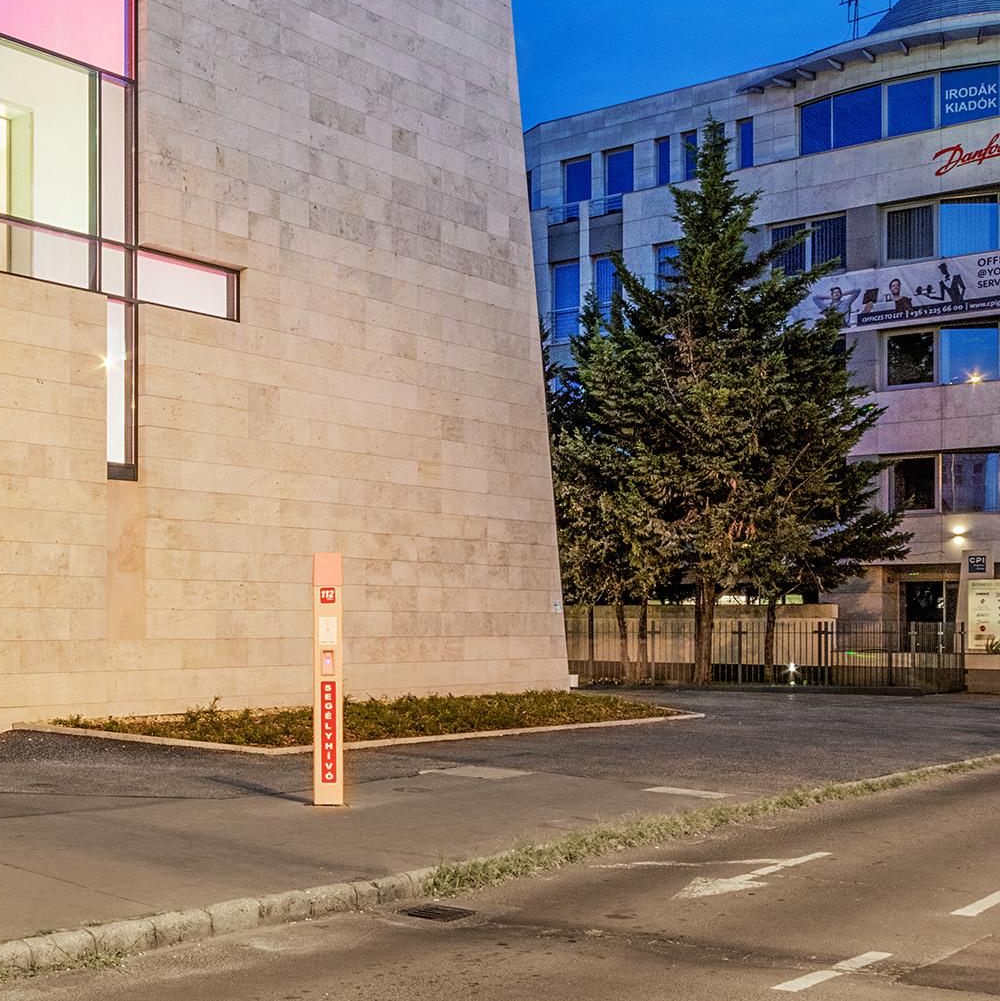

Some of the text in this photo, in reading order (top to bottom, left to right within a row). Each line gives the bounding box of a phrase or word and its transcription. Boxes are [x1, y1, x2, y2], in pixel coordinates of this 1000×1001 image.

[945, 83, 997, 100] IRODÁK
[945, 96, 997, 113] KIADÓK
[861, 314, 885, 323] OFFICES
[909, 309, 923, 318] +36
[928, 307, 941, 316] 225
[942, 304, 952, 312] 66
[969, 556, 985, 564] CPI
[321, 590, 335, 598] 112
[324, 684, 334, 780] SEGÉLYHÍVÓ
